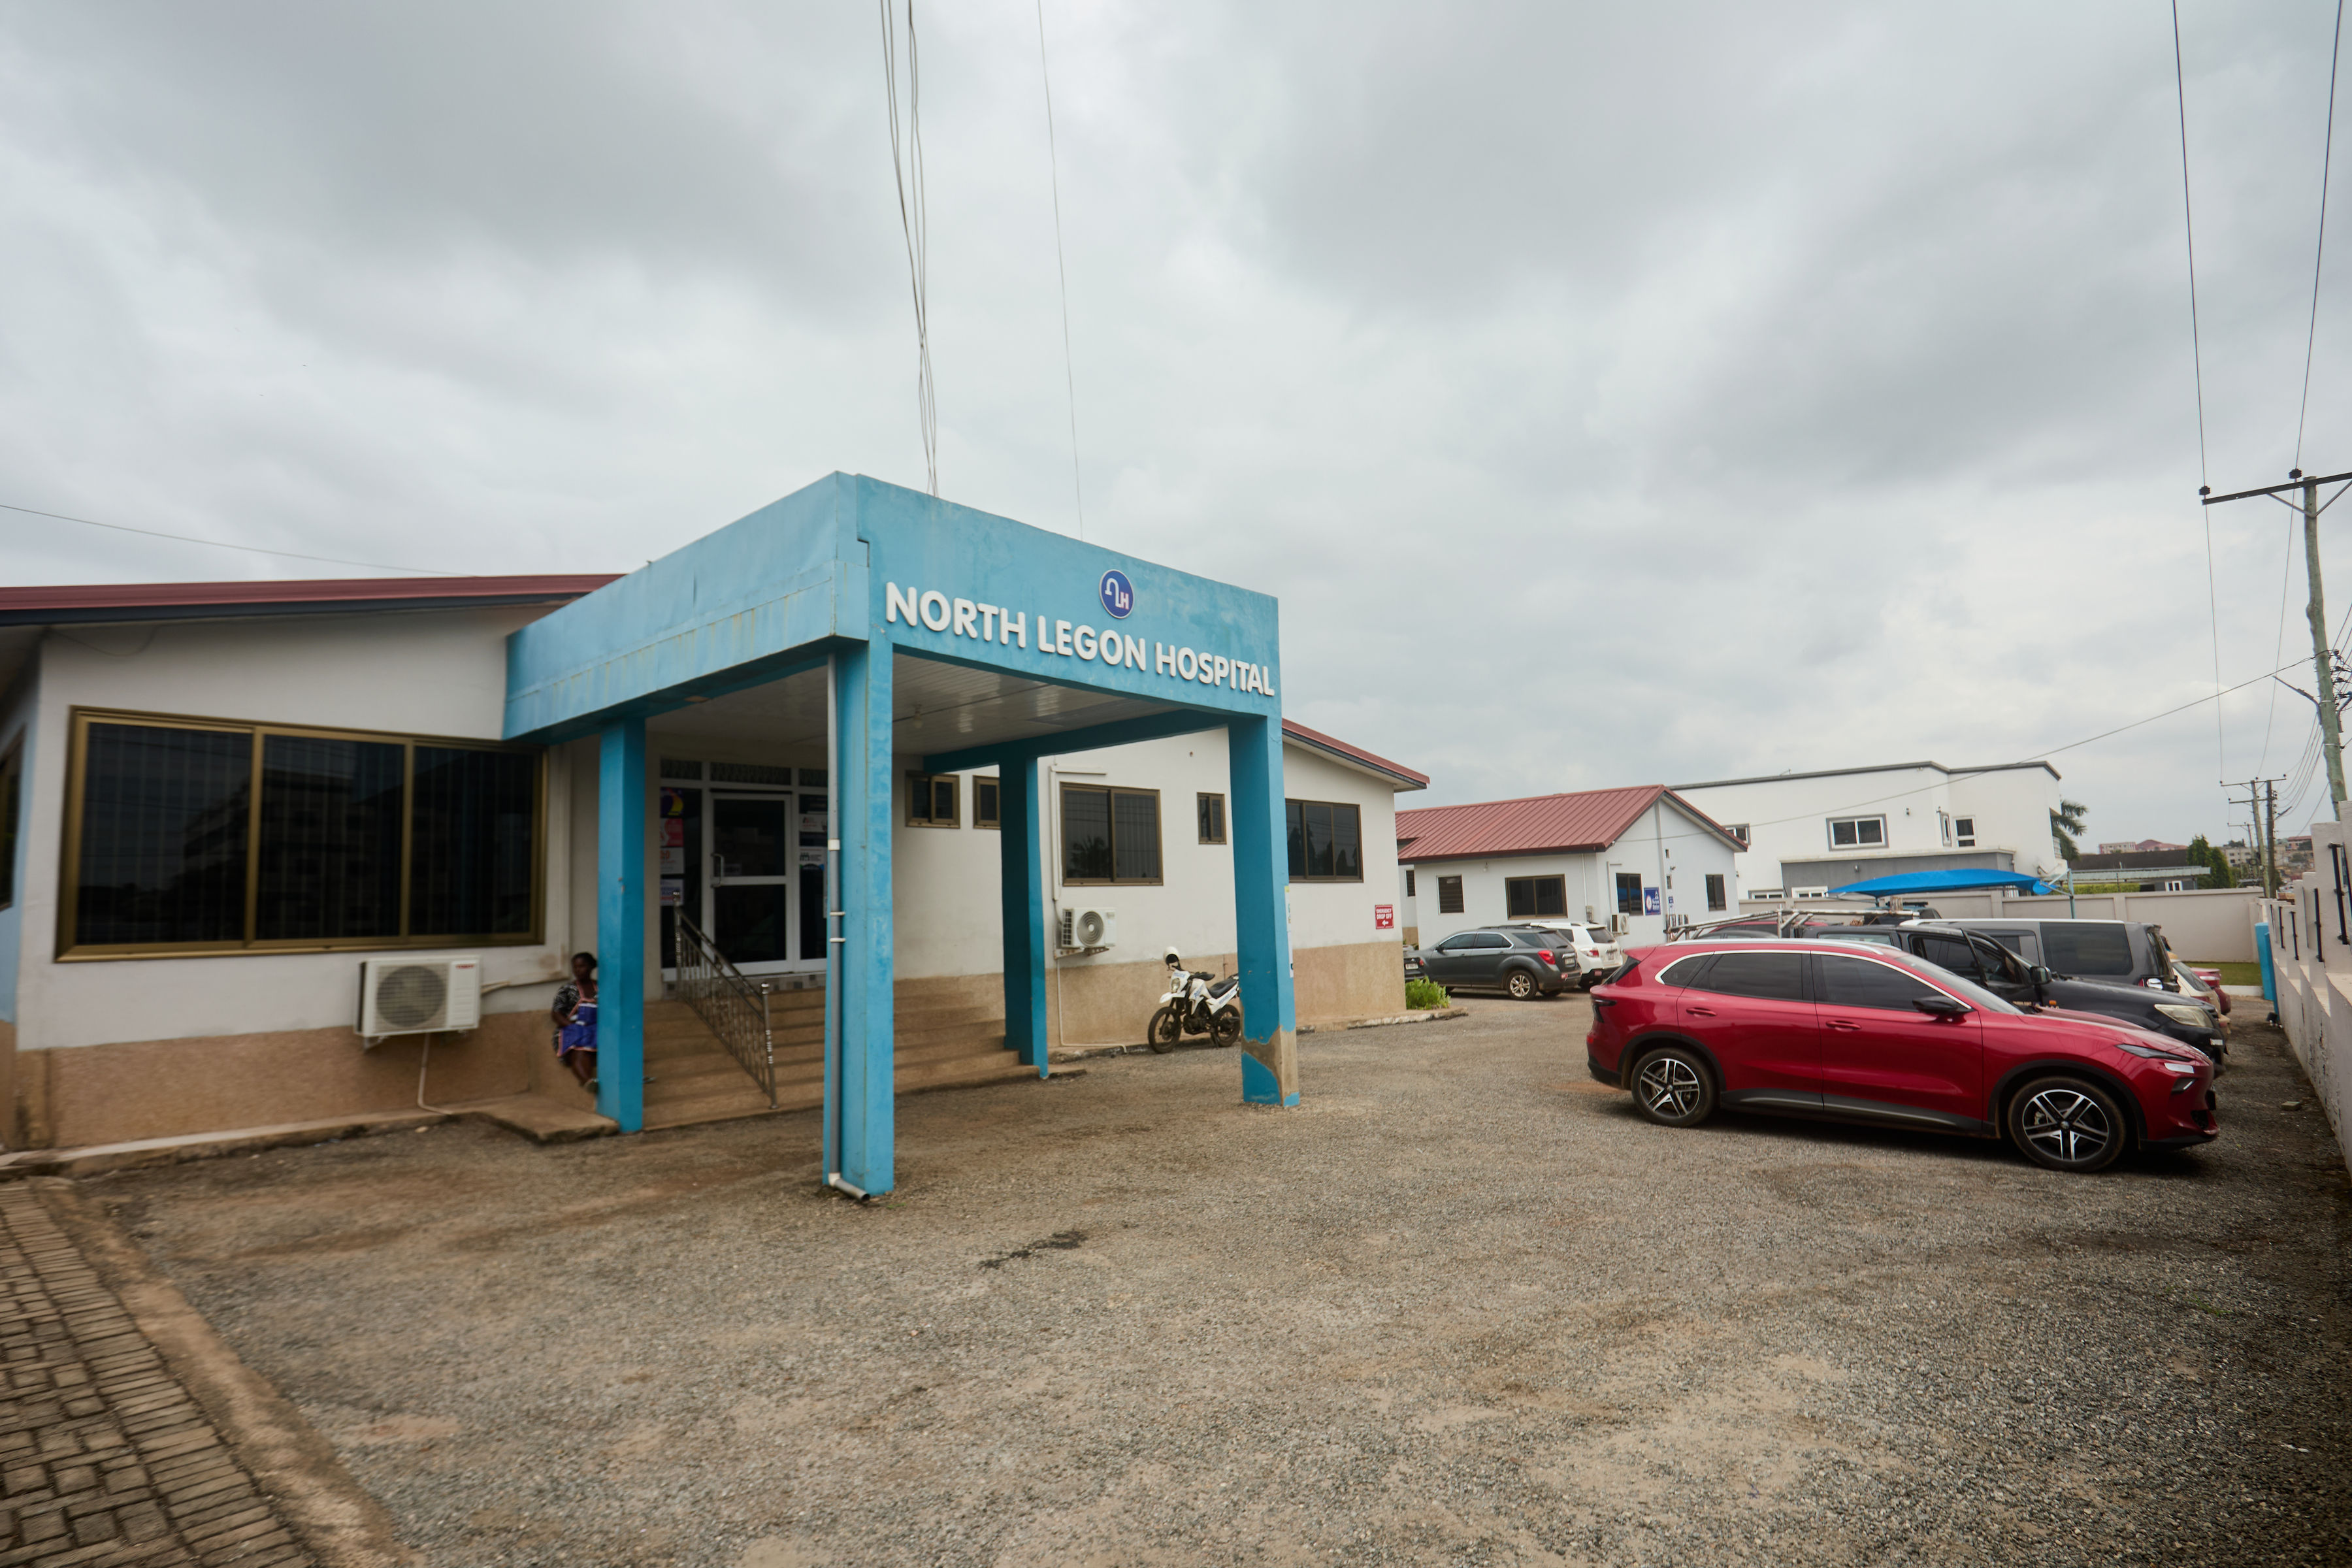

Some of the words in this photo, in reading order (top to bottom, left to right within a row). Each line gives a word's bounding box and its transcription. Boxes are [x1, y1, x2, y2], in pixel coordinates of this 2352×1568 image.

[886, 581, 1026, 649] NORTH
[1037, 615, 1146, 672] LEGON
[1155, 642, 1275, 696] HOSPITAL
